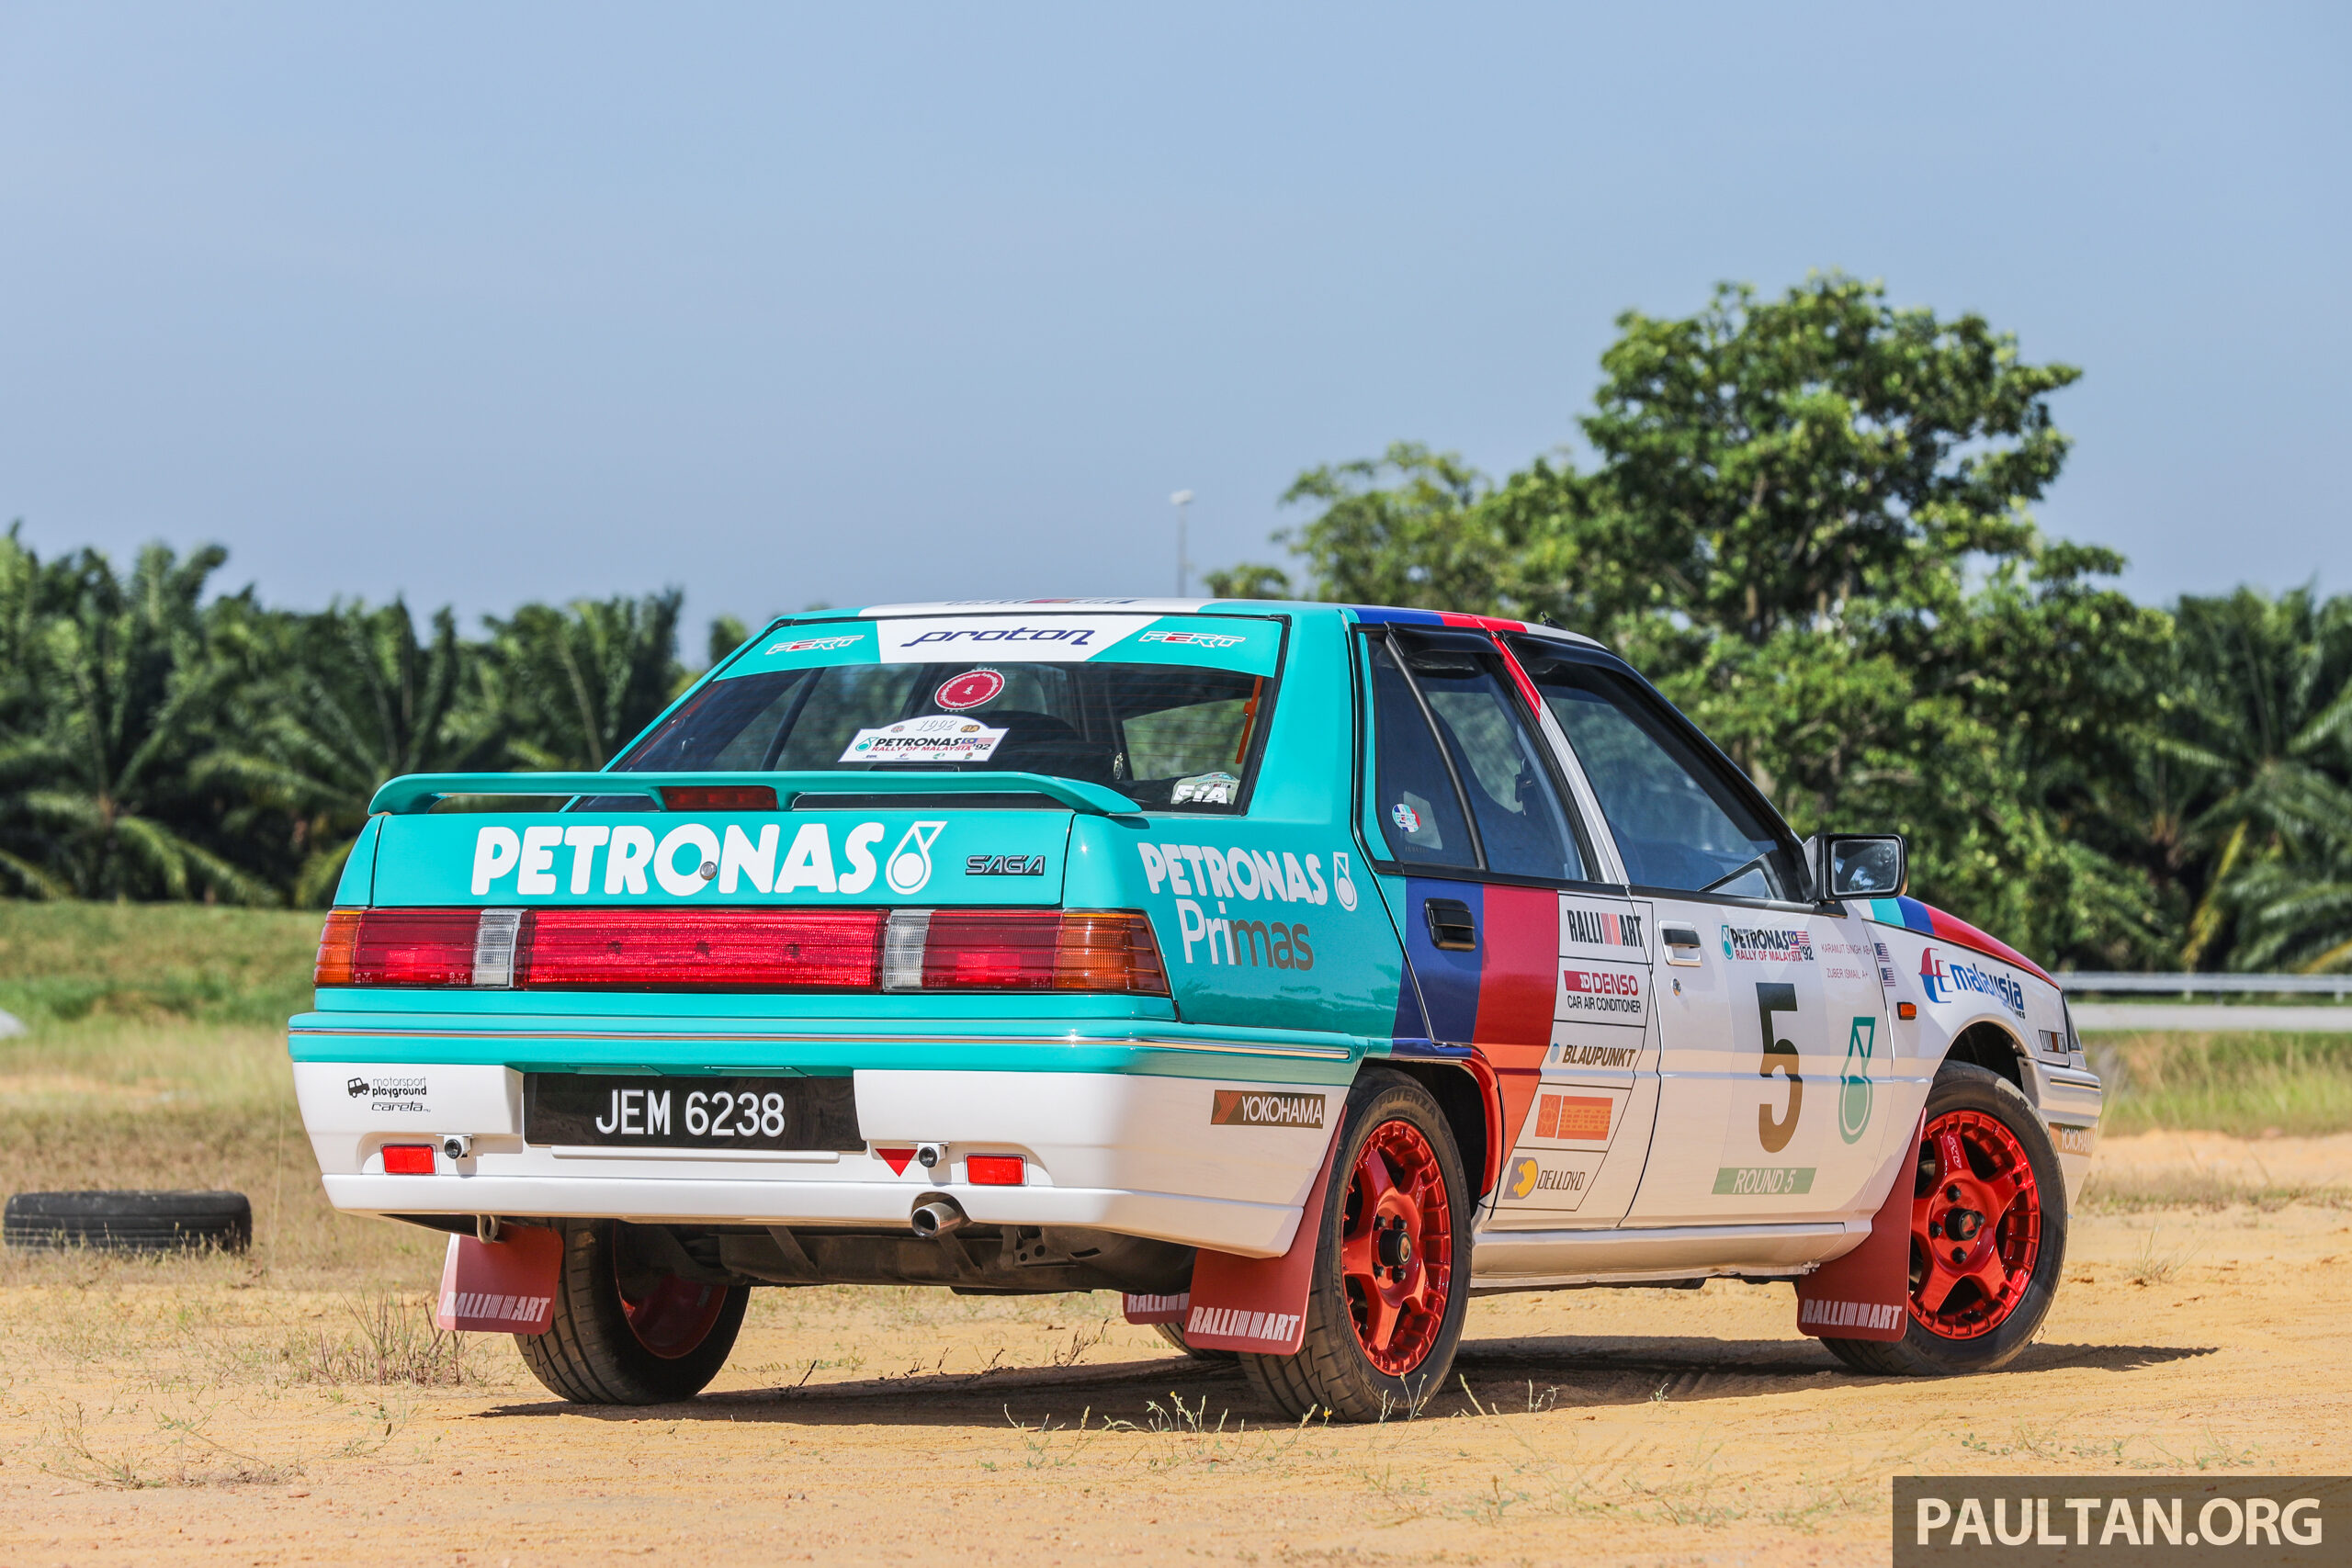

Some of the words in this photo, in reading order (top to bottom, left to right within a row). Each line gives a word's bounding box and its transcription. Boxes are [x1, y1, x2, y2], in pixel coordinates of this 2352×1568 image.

[899, 626, 1095, 656] proton
[916, 719, 957, 732] 1992
[961, 725, 978, 733] FIA
[876, 738, 962, 747] PETRONAS
[471, 823, 885, 897] PETRONAS
[966, 854, 1046, 875] SAGA
[1137, 842, 1328, 906] PETRONAS
[1176, 898, 1314, 971] Primas
[1730, 928, 1790, 951] PETRONAS
[1735, 949, 1757, 961] RALLY
[1758, 951, 1768, 961] OF
[1769, 952, 1804, 962] MALAYSIA
[1799, 946, 1814, 961] '92
[1591, 973, 1639, 997] DENSO
[1950, 963, 2025, 1010] malaysia
[1567, 995, 1583, 1010] CAR
[1584, 997, 1596, 1010] AIR
[1596, 998, 1641, 1013] CONDITIONER
[1563, 1044, 1636, 1067] BLAUPUNKT
[1755, 982, 1804, 1154] 5
[372, 1077, 426, 1088] motorsport
[372, 1086, 427, 1098] playground
[595, 1089, 671, 1135] JEM
[685, 1091, 786, 1138] 6238
[1241, 1095, 1323, 1125] YOKOHAMA
[1537, 1170, 1586, 1191] DELLOYD
[1733, 1169, 1785, 1194] ROUND
[1784, 1170, 1796, 1193] 5
